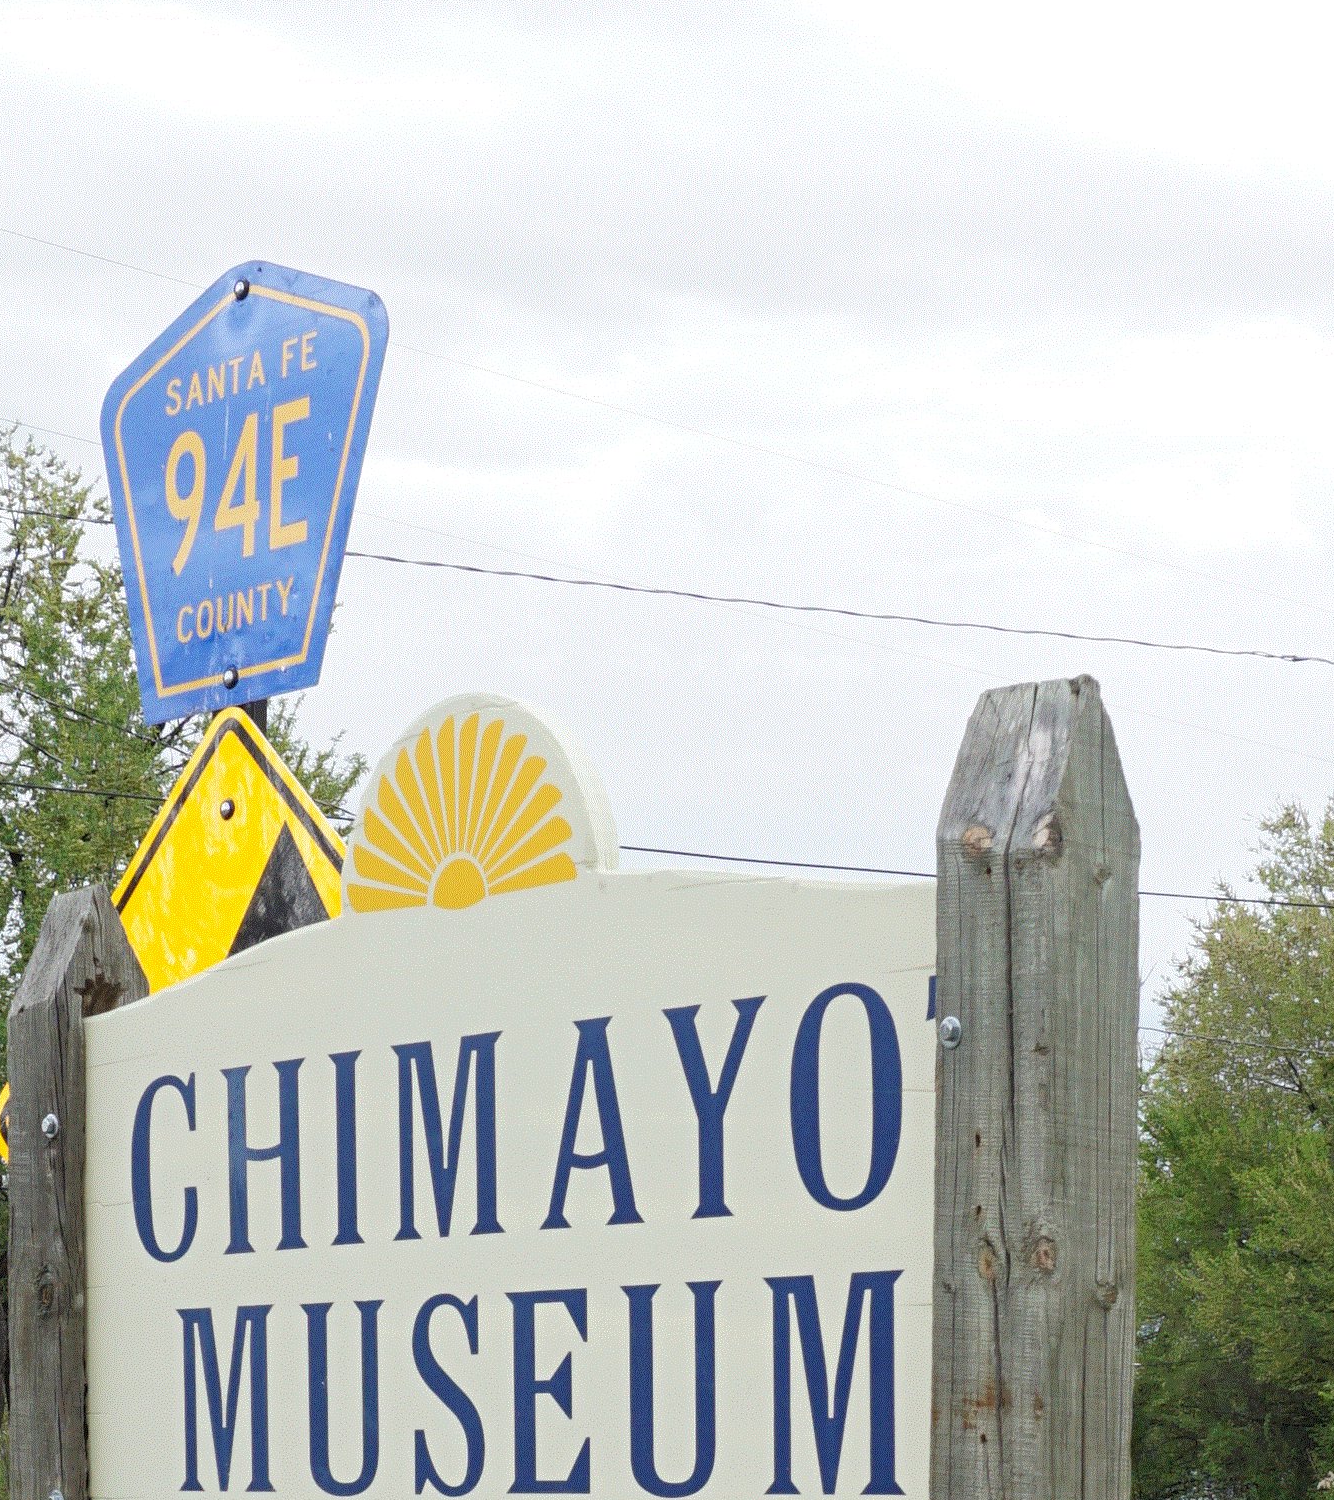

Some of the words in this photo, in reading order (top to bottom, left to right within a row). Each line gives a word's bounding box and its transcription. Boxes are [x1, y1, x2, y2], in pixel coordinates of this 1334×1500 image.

[164, 350, 265, 416] SANTA
[281, 330, 317, 378] FE
[164, 396, 310, 577] 94E
[176, 575, 294, 644] COUNTY
[176, 1269, 905, 1499] MUSEUM
